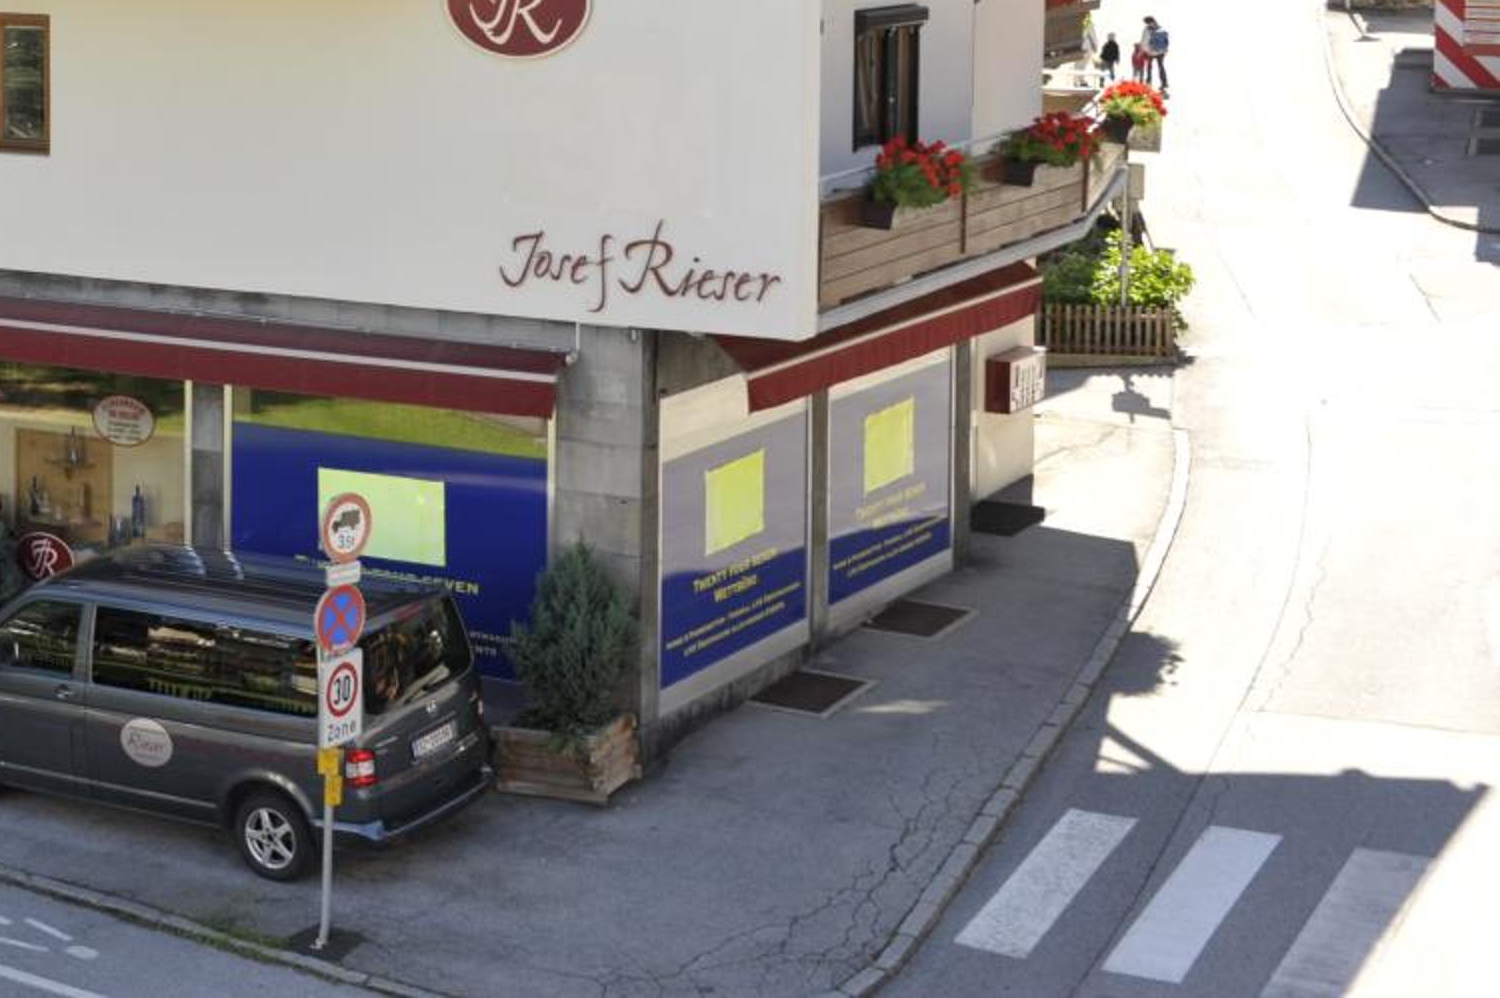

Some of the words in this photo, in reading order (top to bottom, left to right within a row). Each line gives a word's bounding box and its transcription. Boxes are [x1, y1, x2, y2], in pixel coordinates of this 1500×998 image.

[500, 231, 614, 312] Josef
[618, 219, 780, 303] Rieser
[334, 674, 351, 705] 30
[327, 720, 356, 742] Zone
